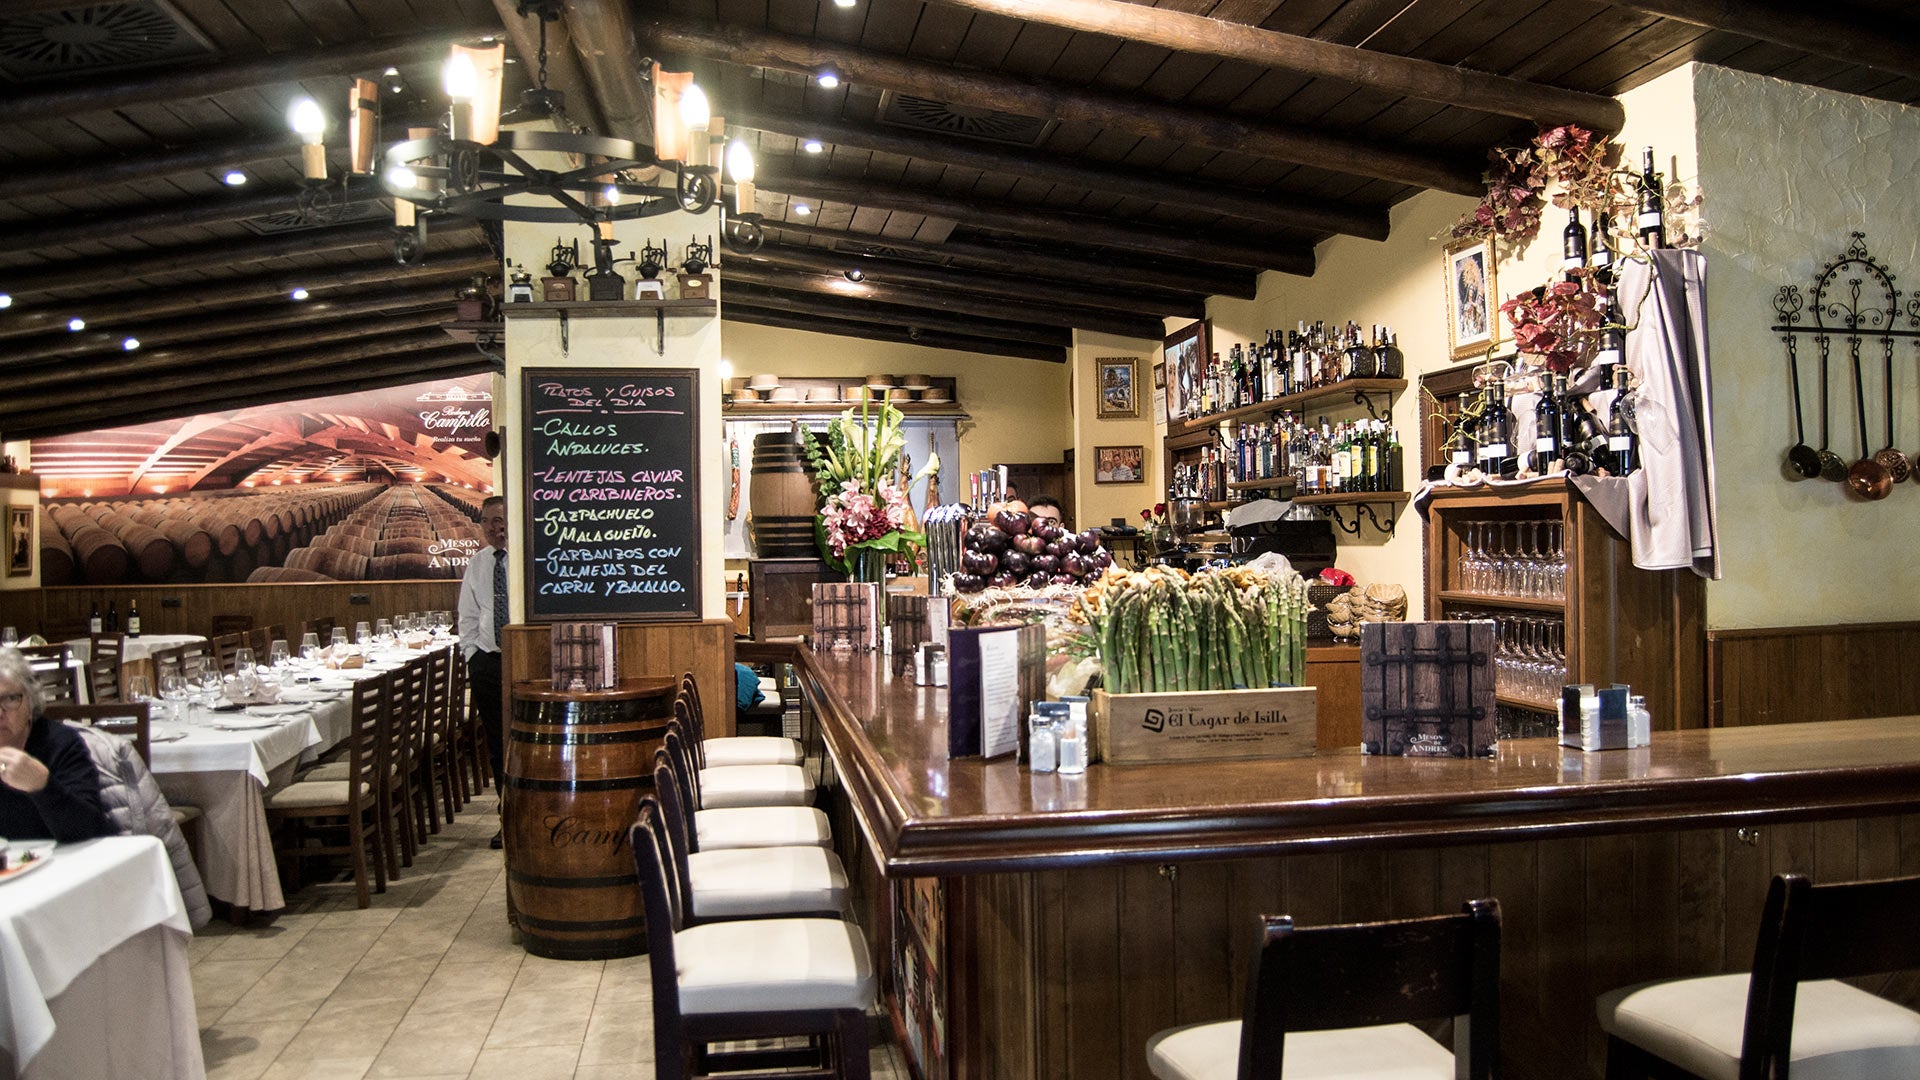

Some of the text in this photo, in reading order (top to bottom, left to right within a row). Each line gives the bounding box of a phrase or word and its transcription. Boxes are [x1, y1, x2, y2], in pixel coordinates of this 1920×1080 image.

[605, 387, 615, 397] Y
[619, 384, 676, 397] GUISOS
[568, 398, 647, 407] DEL DIA
[419, 408, 491, 435] Campillo
[631, 469, 684, 484] CAVIAR
[533, 488, 565, 501] CON
[440, 538, 480, 549] MESON
[648, 546, 682, 559] CON
[428, 556, 470, 569] ANDR
[558, 563, 668, 578] ALMEJAS DEL
[540, 580, 596, 595] CARRIL
[1168, 713, 1183, 728] El
[1233, 711, 1250, 725] de
[1254, 710, 1288, 724] Isilla
[1417, 733, 1443, 741] MESON
[1410, 744, 1448, 753] ANDRES
[543, 814, 631, 856] Camp
